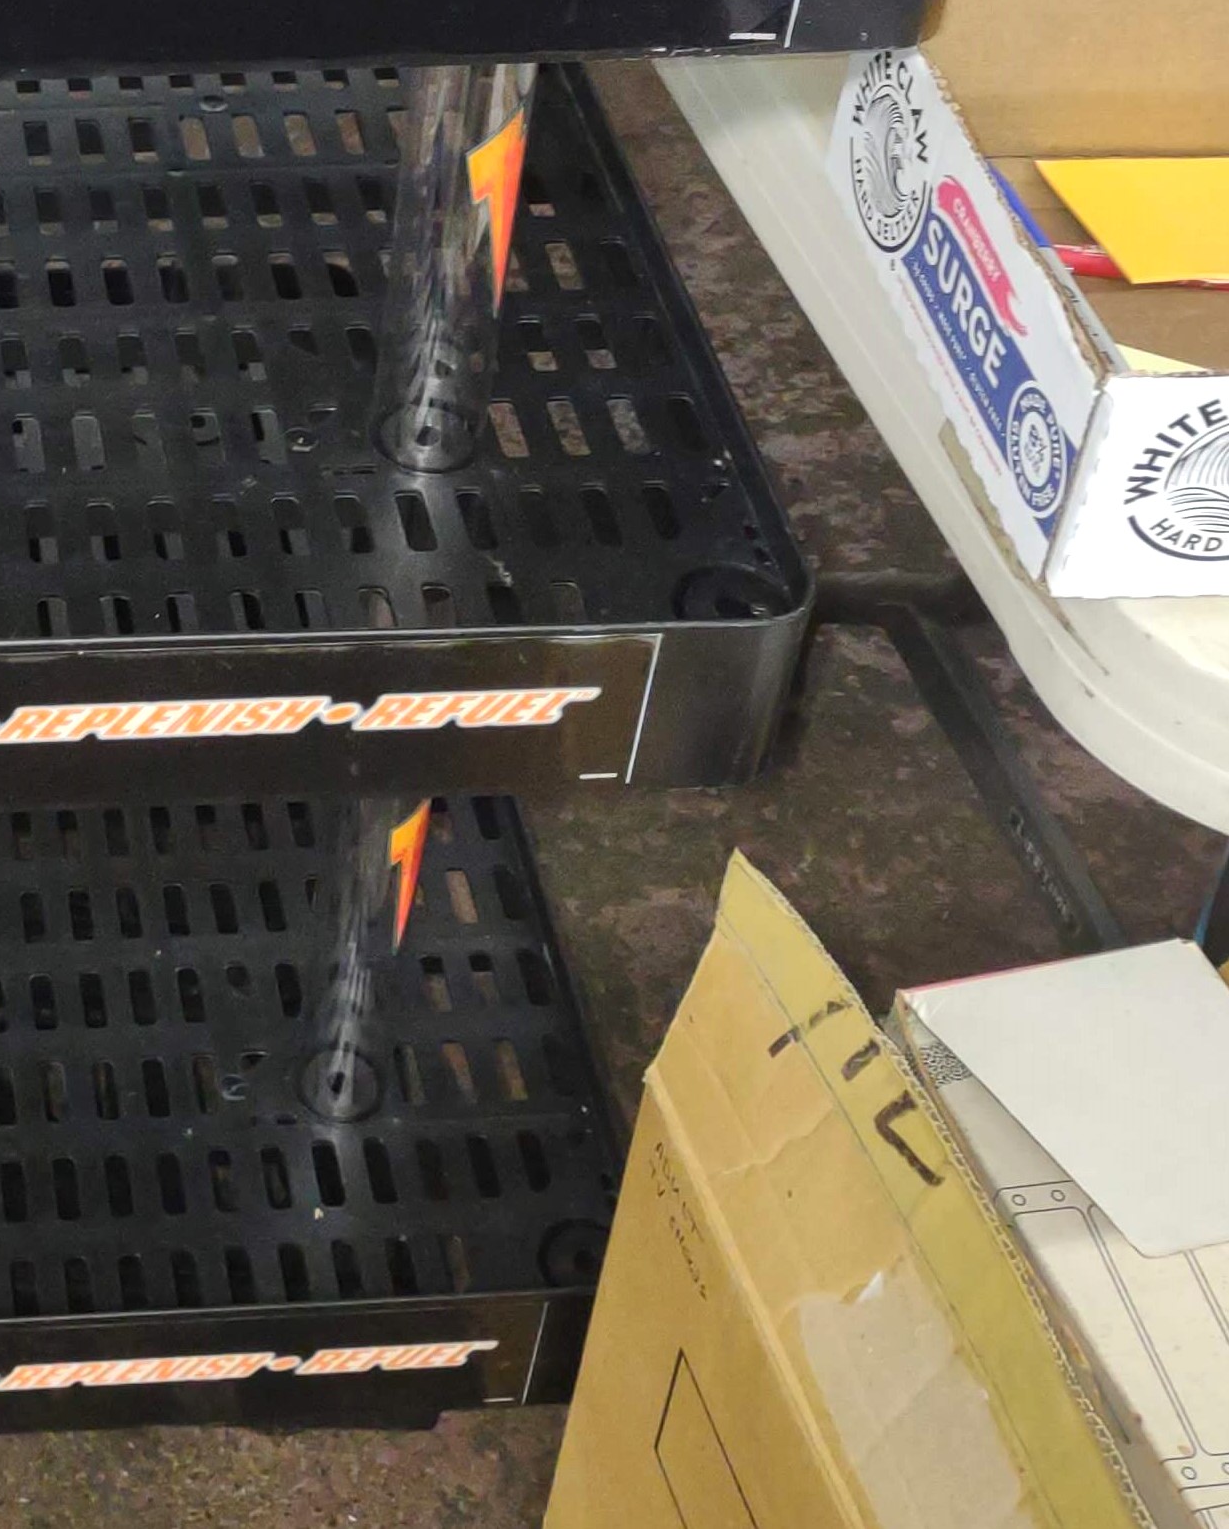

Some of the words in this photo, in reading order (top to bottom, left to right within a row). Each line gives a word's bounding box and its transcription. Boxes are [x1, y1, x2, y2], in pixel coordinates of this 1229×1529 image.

[852, 51, 893, 125] WHITE
[895, 60, 929, 164] CLAW
[922, 219, 1008, 390] SURGE
[1123, 398, 1228, 506] WHITE
[1148, 517, 1224, 554] HARD
[352, 690, 572, 730] REFUEL
